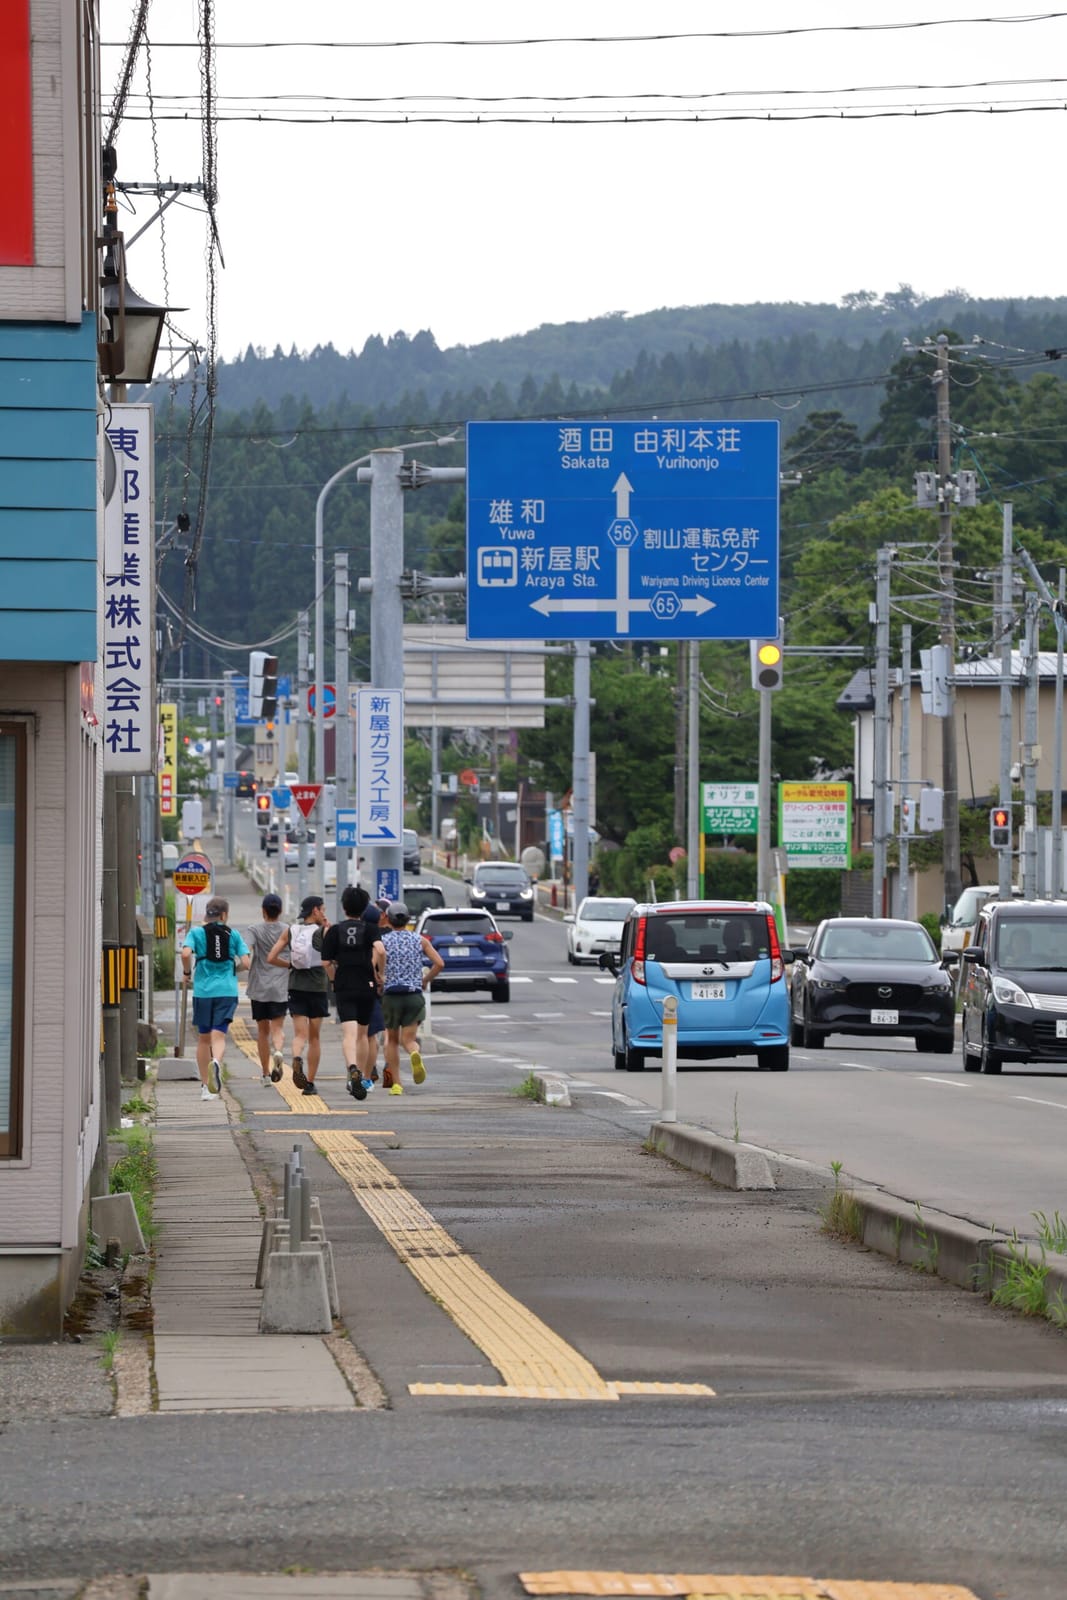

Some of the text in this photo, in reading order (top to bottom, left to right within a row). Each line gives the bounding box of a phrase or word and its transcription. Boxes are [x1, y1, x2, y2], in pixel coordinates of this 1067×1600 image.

[558, 428, 741, 453] 酒田 由利本荘
[561, 455, 719, 471] Sakata Yurihonjo
[489, 499, 545, 524] 雄和
[499, 527, 535, 541] Yuwa
[613, 525, 632, 541] 56
[643, 528, 760, 549] 割山運転免許
[521, 546, 601, 571] 新屋駅
[691, 552, 769, 572] センター
[525, 574, 598, 589] Araya Sta.
[641, 575, 770, 589] Wariyama Driving Licence Center
[656, 597, 675, 613] 65
[369, 696, 391, 822] 新屋ガラス工房
